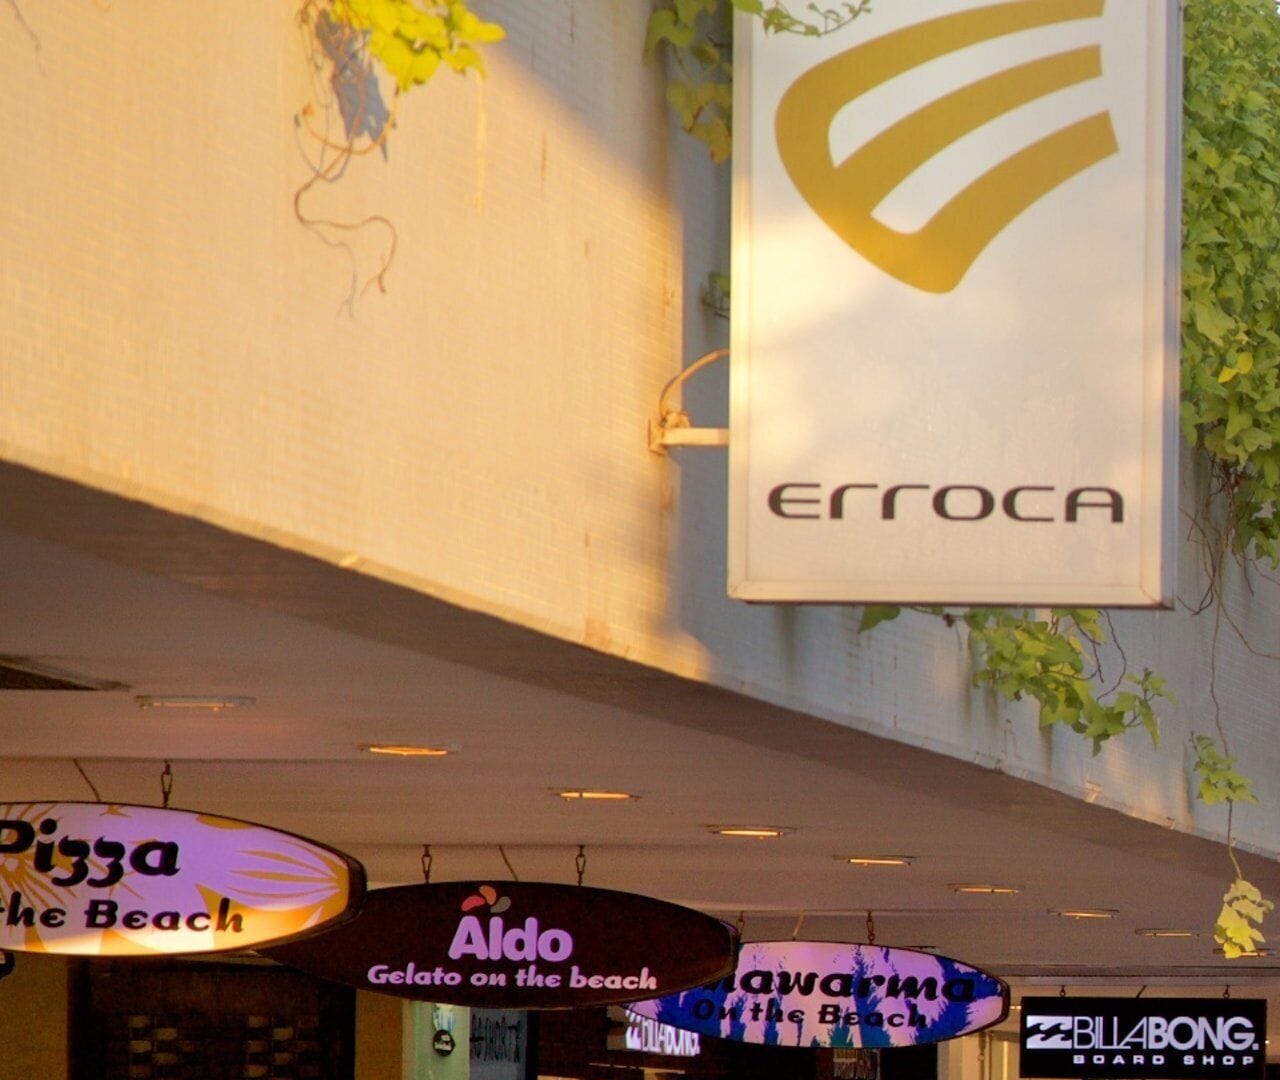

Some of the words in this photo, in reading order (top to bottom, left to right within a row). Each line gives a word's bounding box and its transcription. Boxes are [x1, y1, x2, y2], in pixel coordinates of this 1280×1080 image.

[0, 891, 67, 928] he
[84, 897, 243, 932] Beach
[448, 915, 573, 962] Aldo
[367, 962, 462, 986] Gelato
[470, 972, 507, 988] on
[515, 965, 561, 988] the
[569, 966, 657, 990] beach
[706, 969, 976, 1002] awarma
[693, 998, 737, 1022] On
[750, 998, 804, 1024] the
[818, 1003, 927, 1029] Beach
[1073, 1055, 1165, 1065] BOARD
[1183, 1055, 1254, 1066] SHOP
